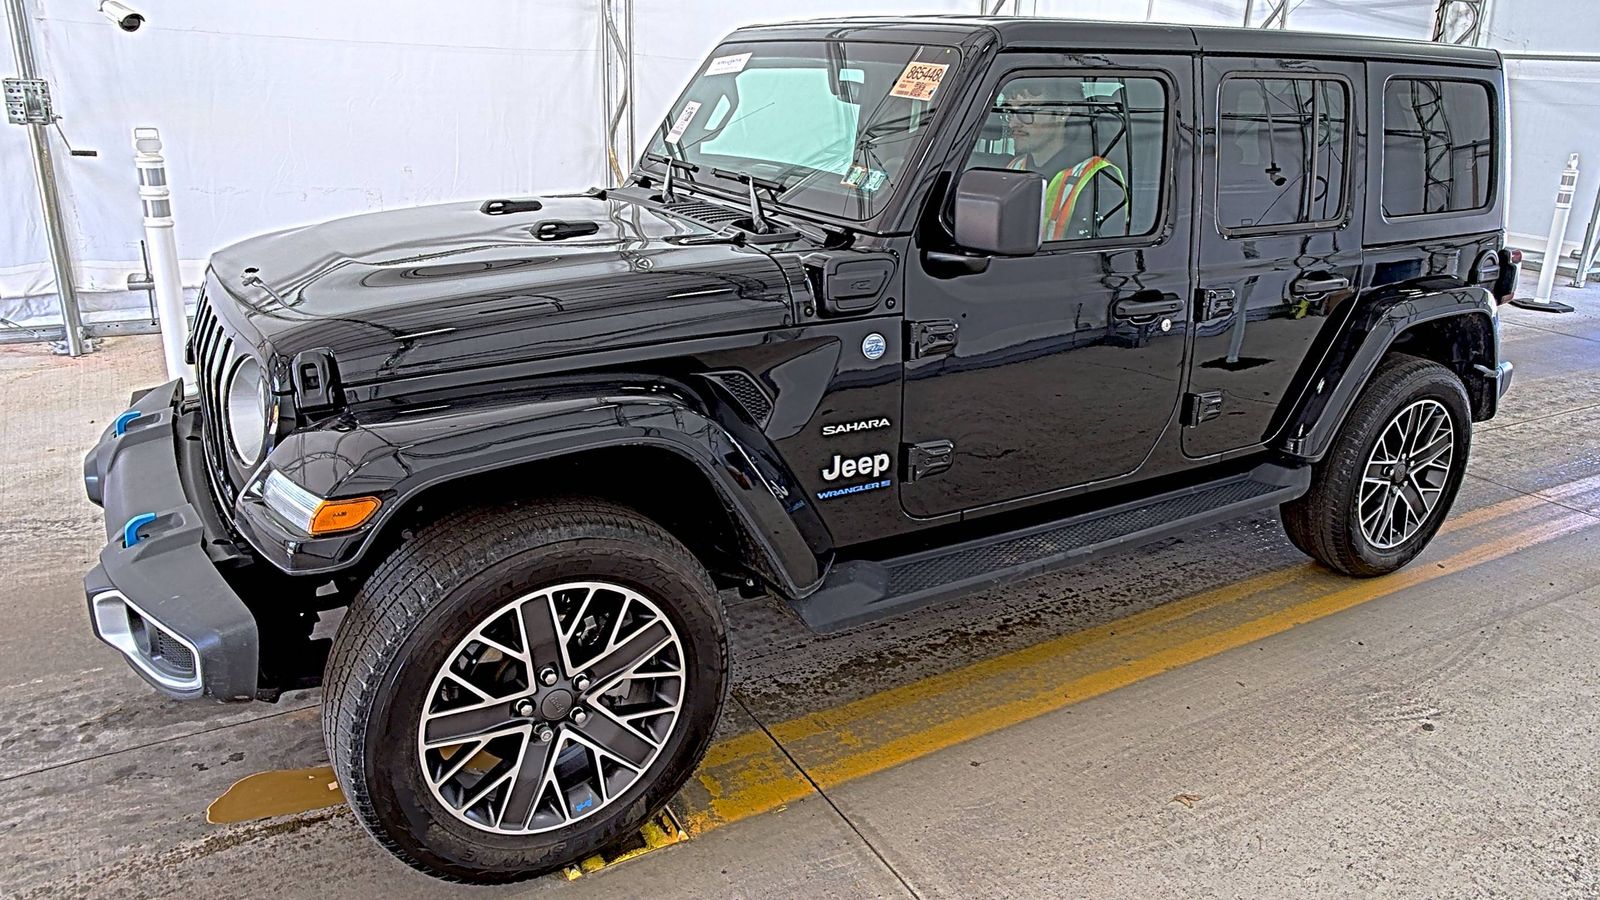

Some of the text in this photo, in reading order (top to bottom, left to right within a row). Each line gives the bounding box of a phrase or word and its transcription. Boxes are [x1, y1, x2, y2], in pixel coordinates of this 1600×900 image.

[822, 418, 890, 436] SAHARA
[822, 453, 890, 481] Jeep
[817, 482, 880, 499] WRANGLER
